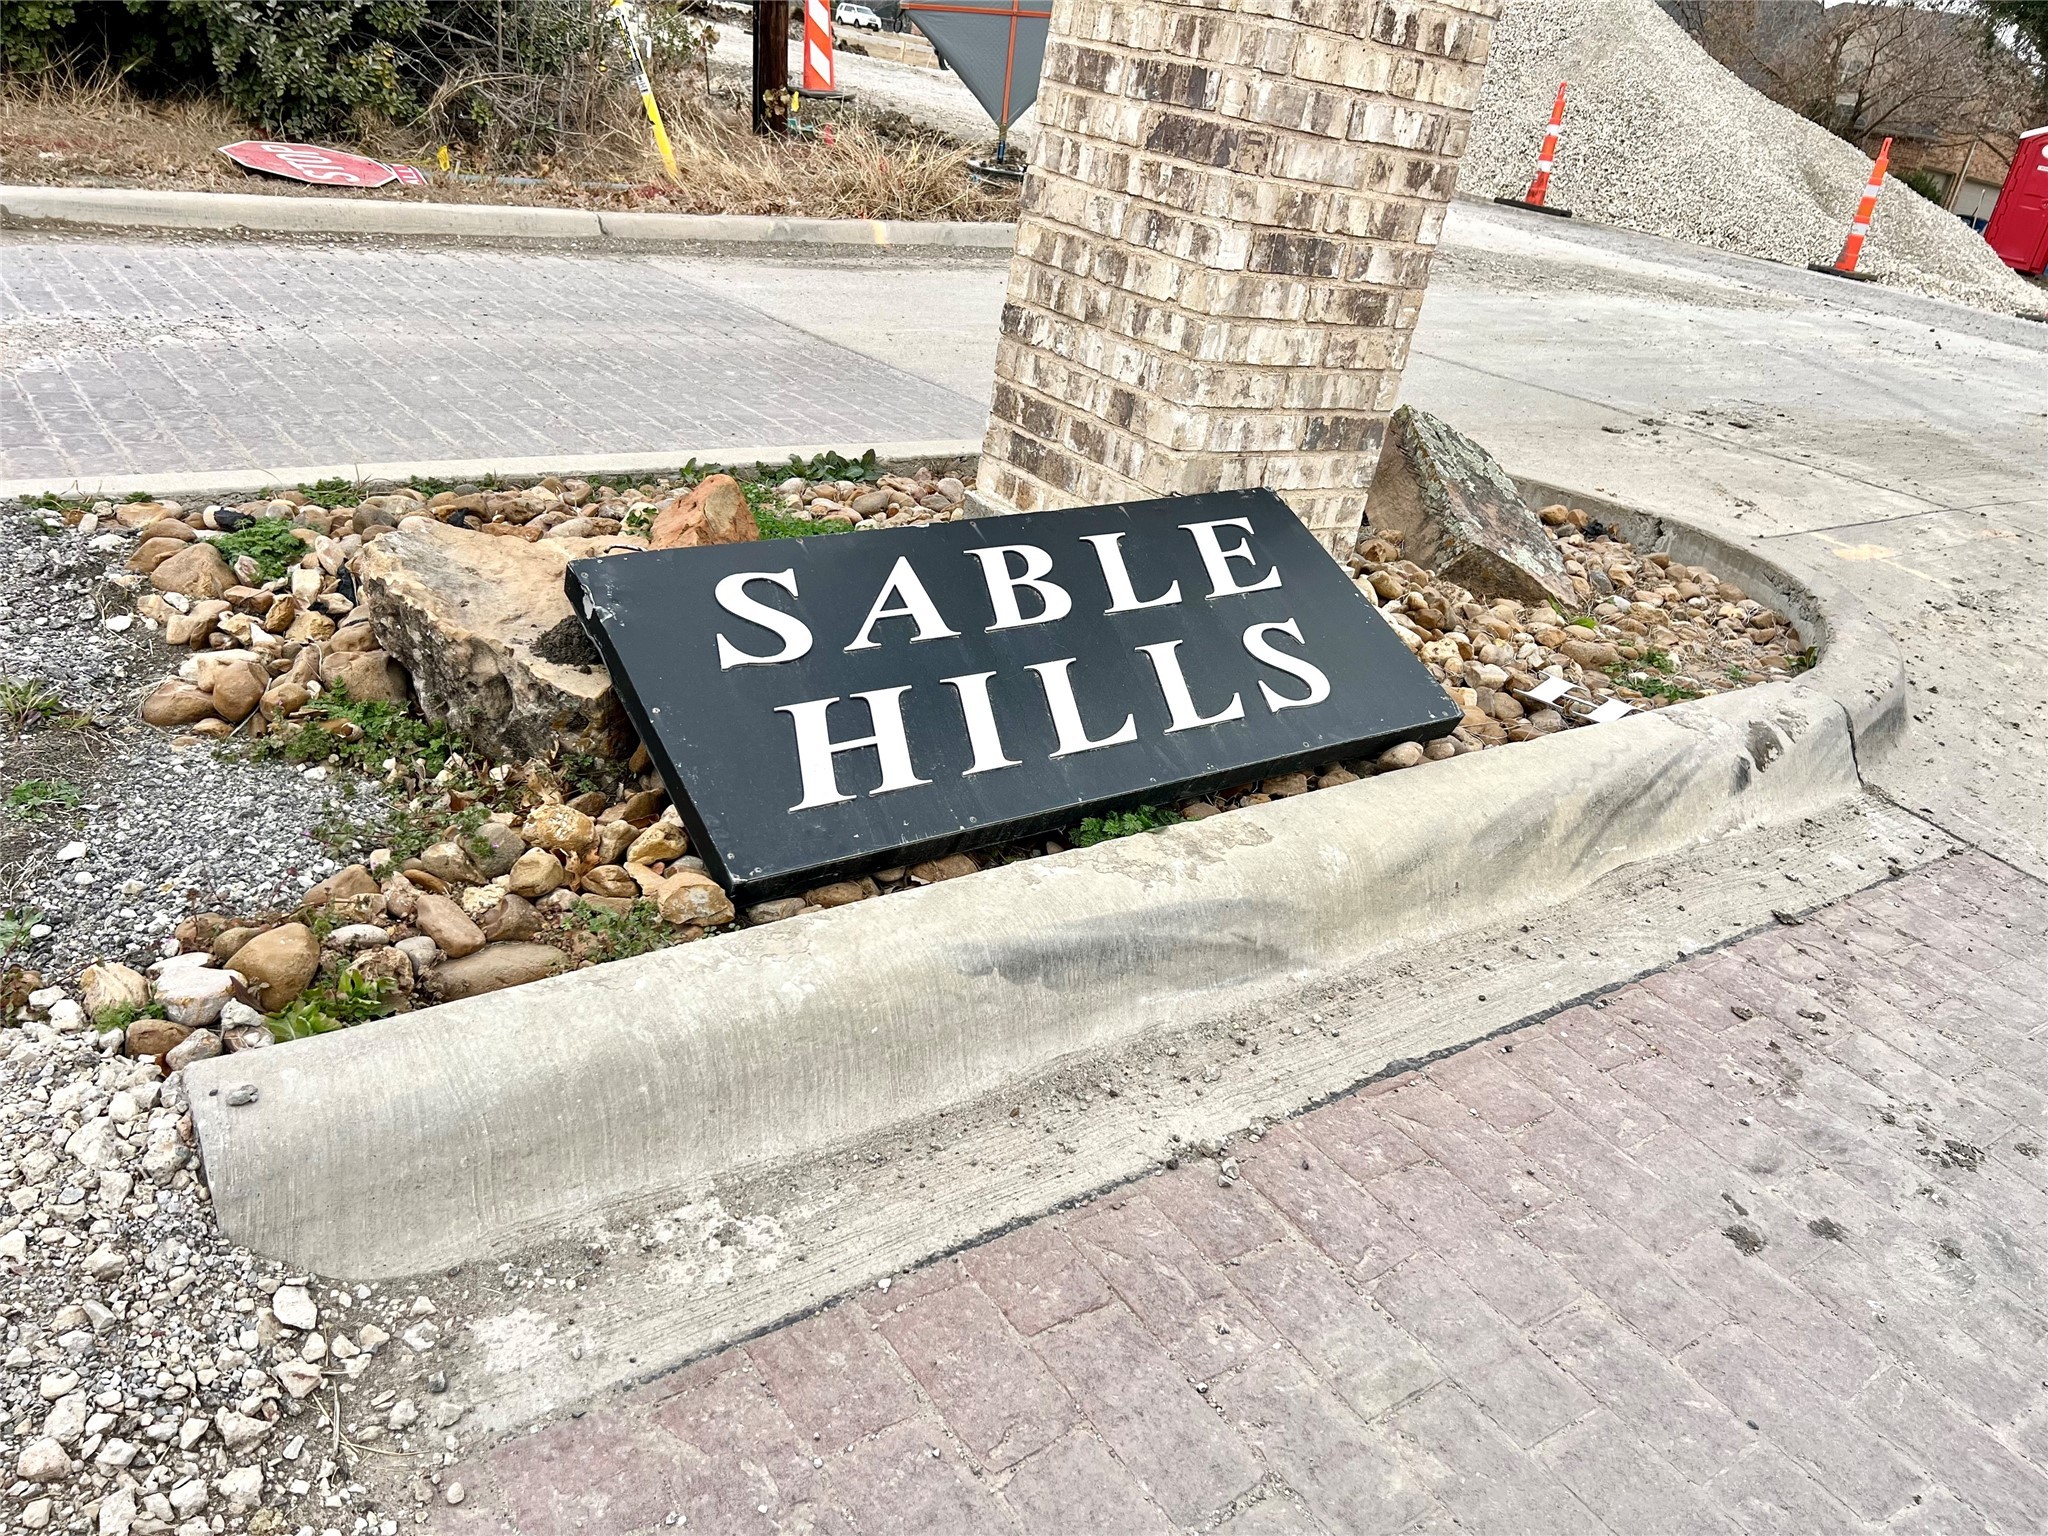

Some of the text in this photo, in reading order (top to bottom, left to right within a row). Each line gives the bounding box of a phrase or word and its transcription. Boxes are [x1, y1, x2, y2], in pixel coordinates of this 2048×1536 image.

[260, 144, 361, 183] STOP
[714, 516, 1283, 671] SABLE
[773, 617, 1332, 813] HILLS
